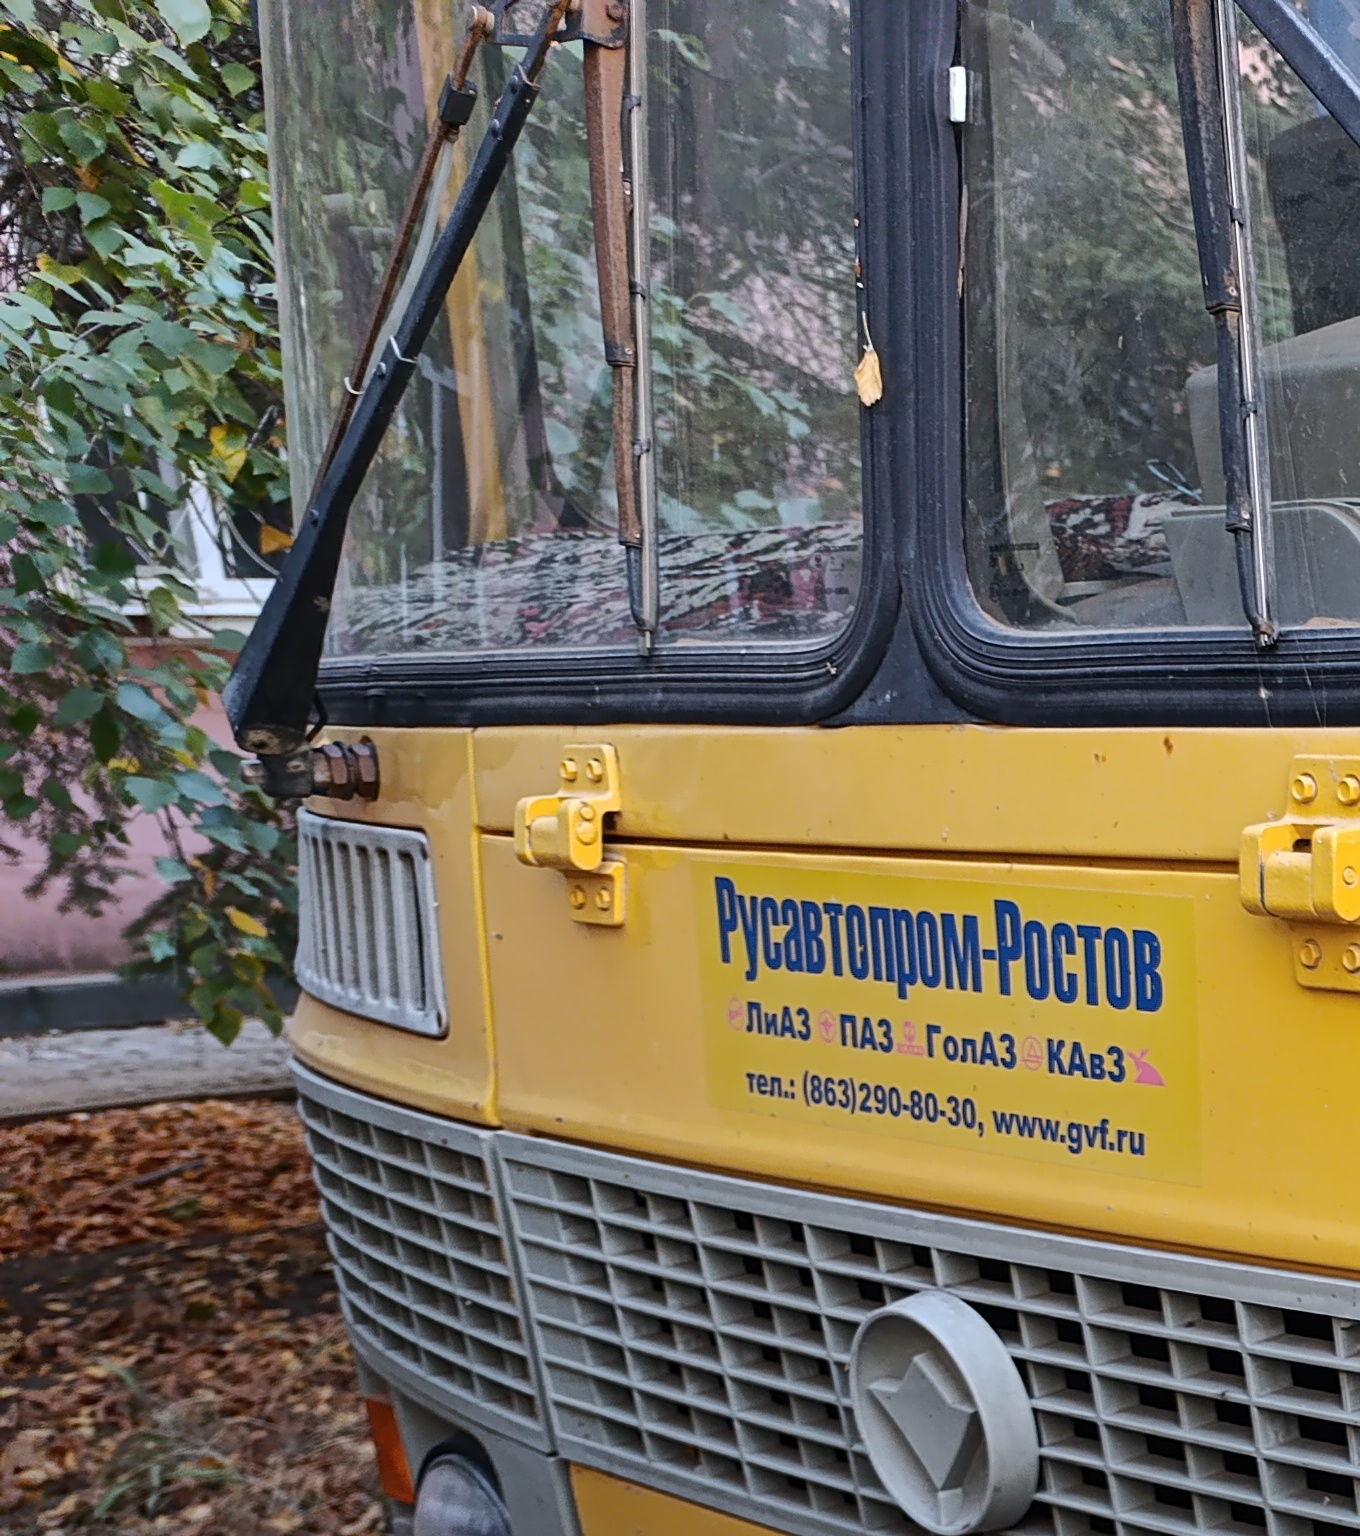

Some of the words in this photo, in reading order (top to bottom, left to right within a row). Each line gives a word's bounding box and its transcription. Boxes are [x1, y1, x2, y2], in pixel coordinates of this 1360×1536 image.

[714, 876, 1164, 1012] Русавтопром-Ростов
[746, 1001, 811, 1041] ЛиАЗ
[840, 1014, 893, 1053] ПАЗ
[926, 1024, 1017, 1069] ГолАЗ
[1046, 1038, 1126, 1083] КАвЗ
[746, 1071, 796, 1100] тел.:
[993, 1109, 1145, 1156] www.gvf.ru
